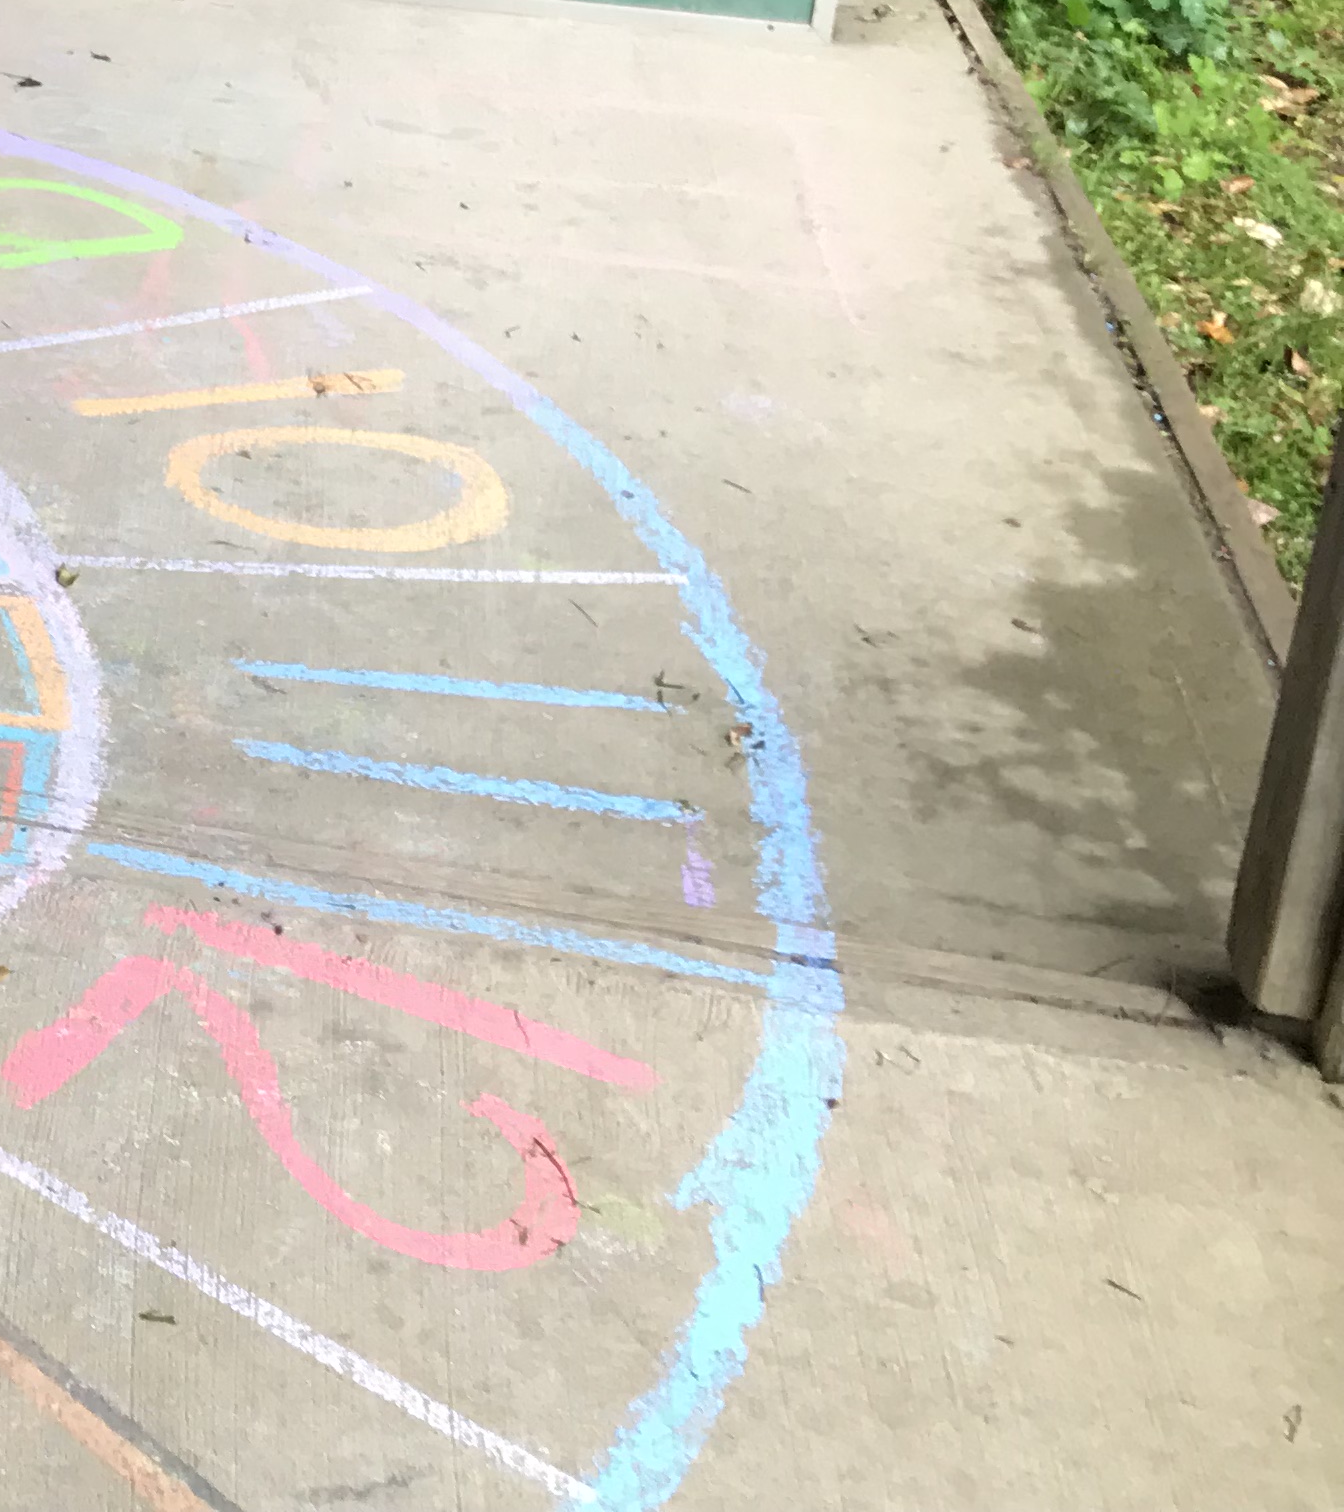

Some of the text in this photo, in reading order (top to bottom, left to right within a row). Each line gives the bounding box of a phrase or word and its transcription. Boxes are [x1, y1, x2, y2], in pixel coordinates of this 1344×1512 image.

[70, 368, 512, 553] 10
[230, 656, 700, 823] 11
[0, 903, 666, 1273] 12
